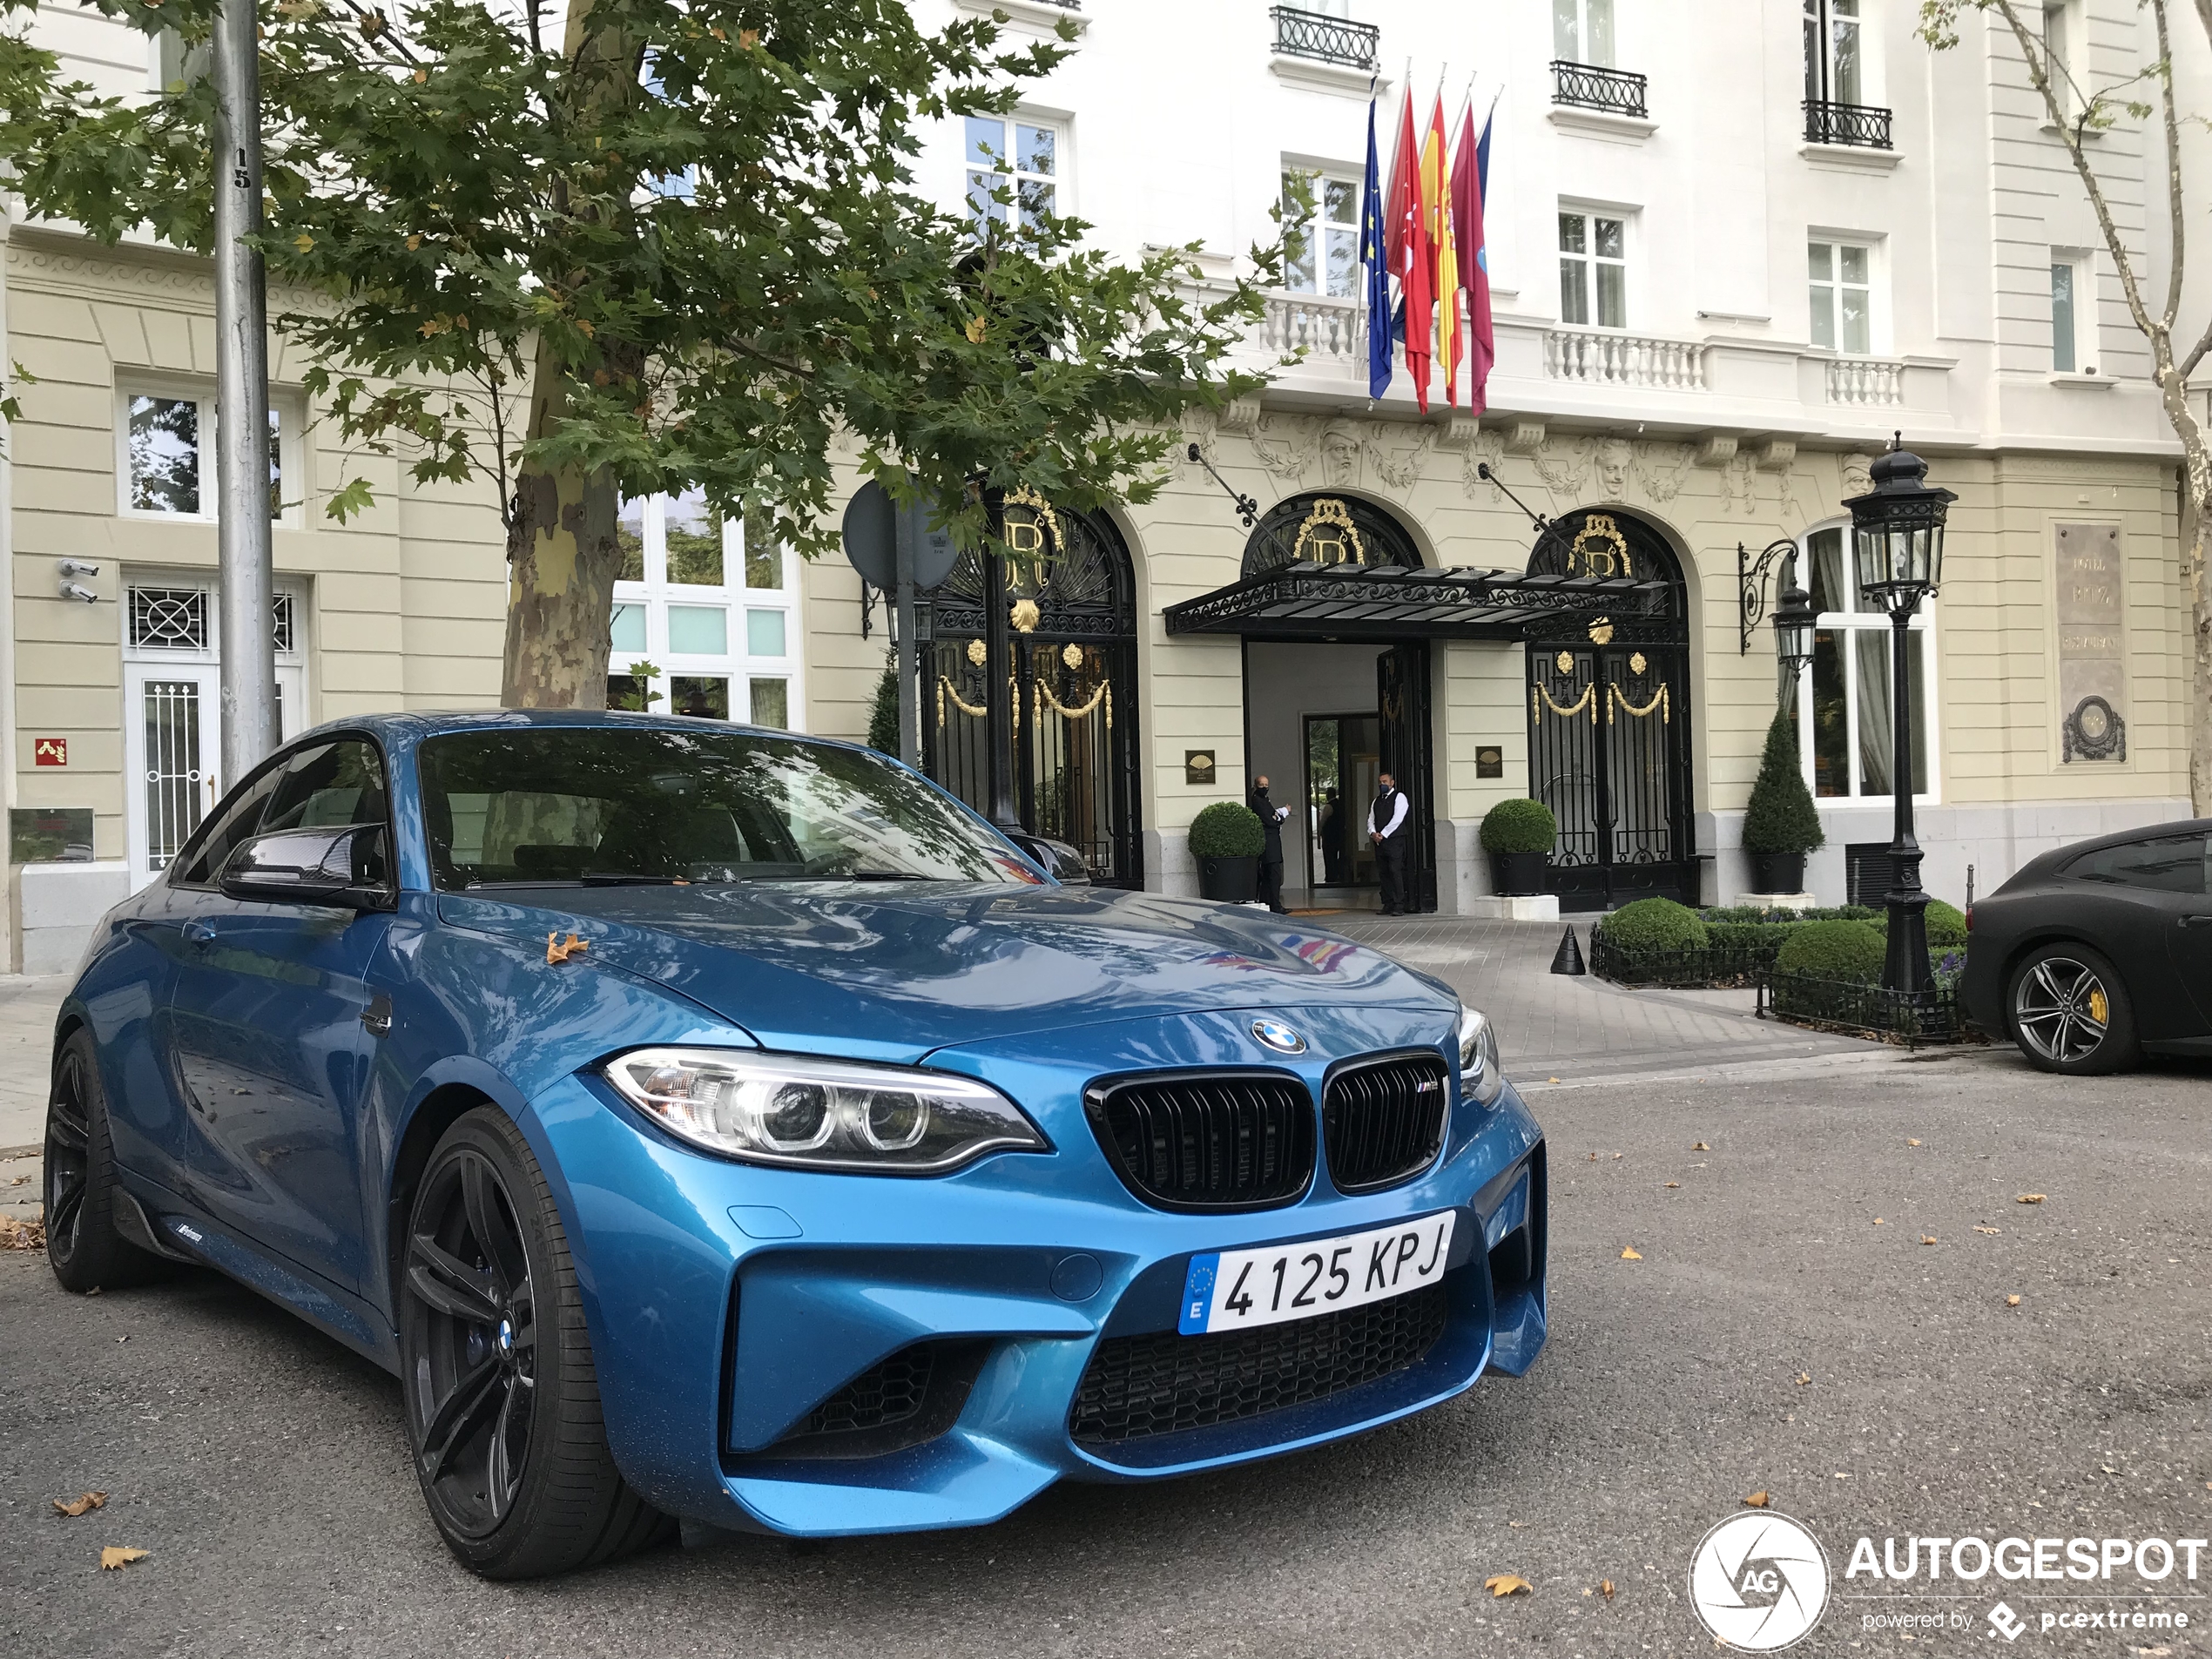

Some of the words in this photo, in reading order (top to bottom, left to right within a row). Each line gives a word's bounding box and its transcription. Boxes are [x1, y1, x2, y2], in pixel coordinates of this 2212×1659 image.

[2074, 557, 2106, 571] HOTEL
[2072, 584, 2109, 604] RITZ
[1224, 1246, 1352, 1316] 4125
[1365, 1223, 1445, 1292] KPJ
[1190, 1301, 1204, 1318] E
